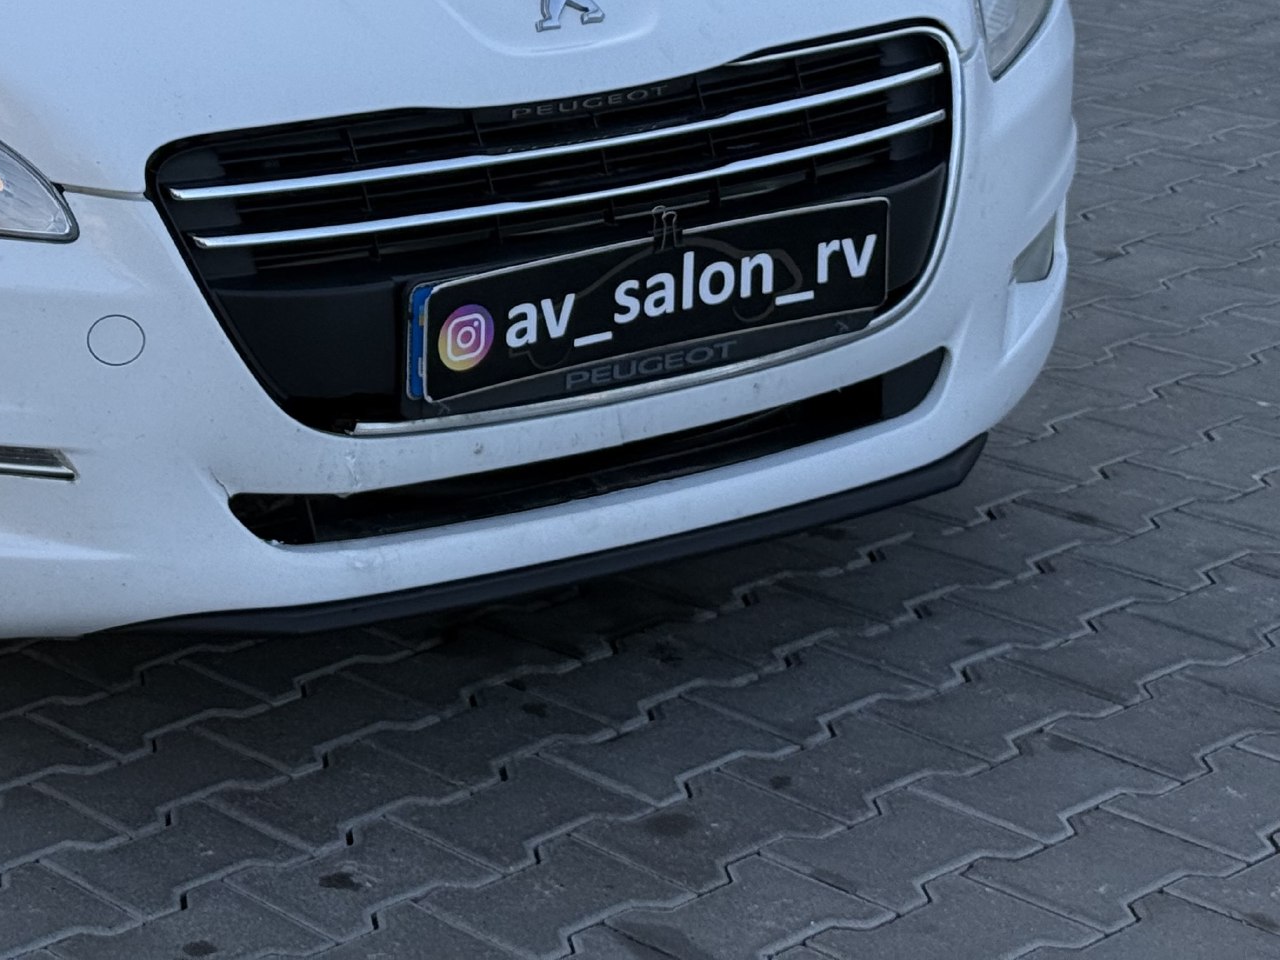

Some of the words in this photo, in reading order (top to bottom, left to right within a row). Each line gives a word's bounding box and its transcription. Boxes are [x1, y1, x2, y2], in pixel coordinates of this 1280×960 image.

[511, 84, 669, 120] PEUGEOT
[506, 233, 877, 349] av_salon_rv
[565, 340, 738, 390] PEUGEOT
